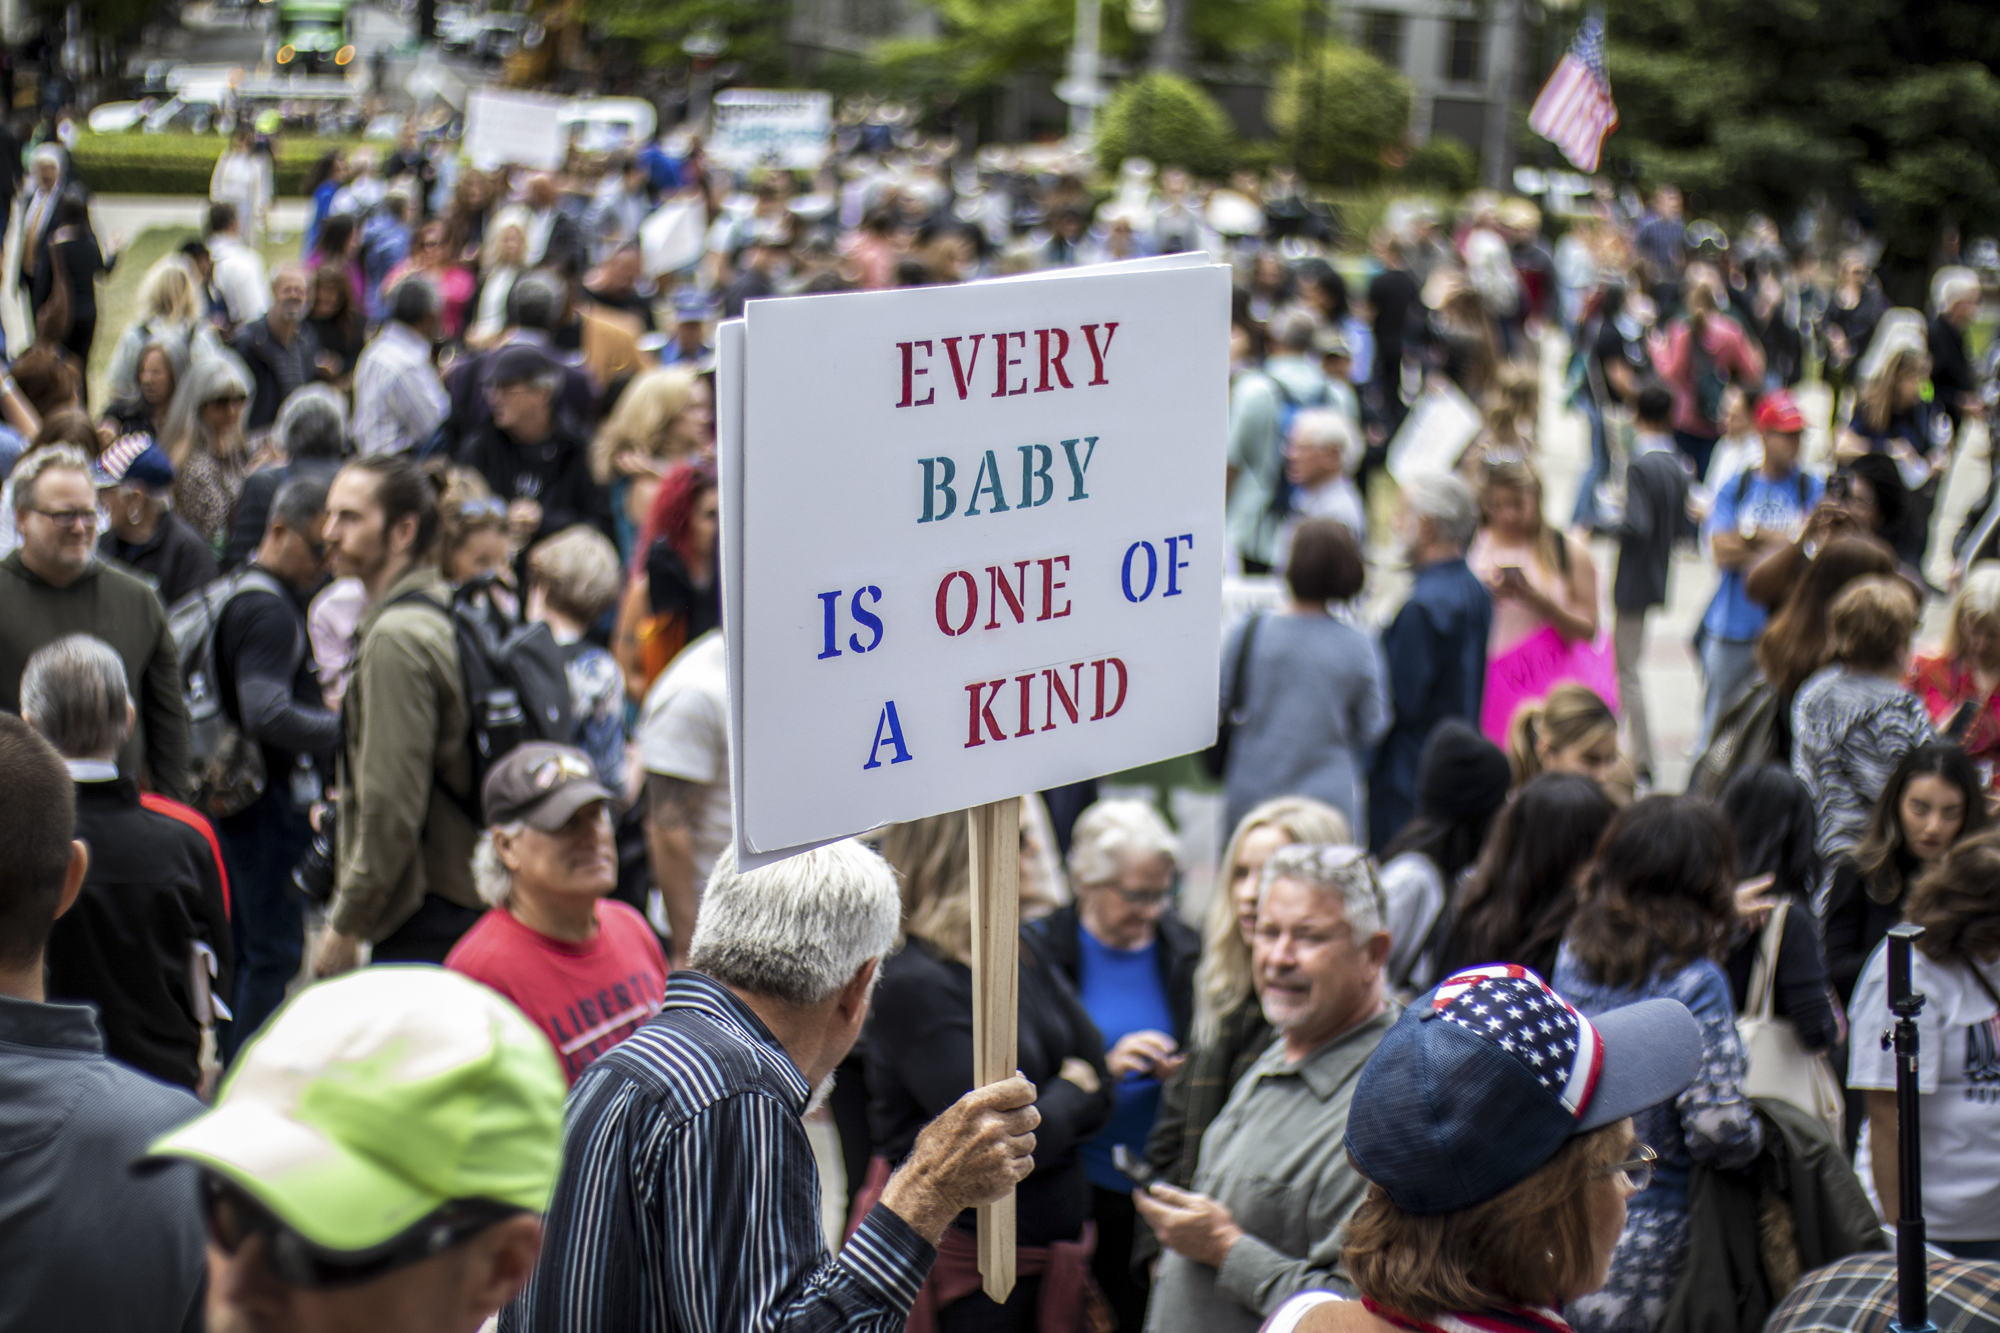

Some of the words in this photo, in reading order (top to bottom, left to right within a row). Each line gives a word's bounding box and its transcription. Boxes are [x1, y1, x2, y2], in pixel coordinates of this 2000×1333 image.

[895, 322, 1119, 408] EVERY
[916, 435, 1100, 524] BABY
[817, 585, 884, 660] IS
[935, 555, 1071, 637] ONE
[1121, 533, 1194, 603] OF
[863, 700, 913, 770] A
[964, 657, 1128, 749] KIND
